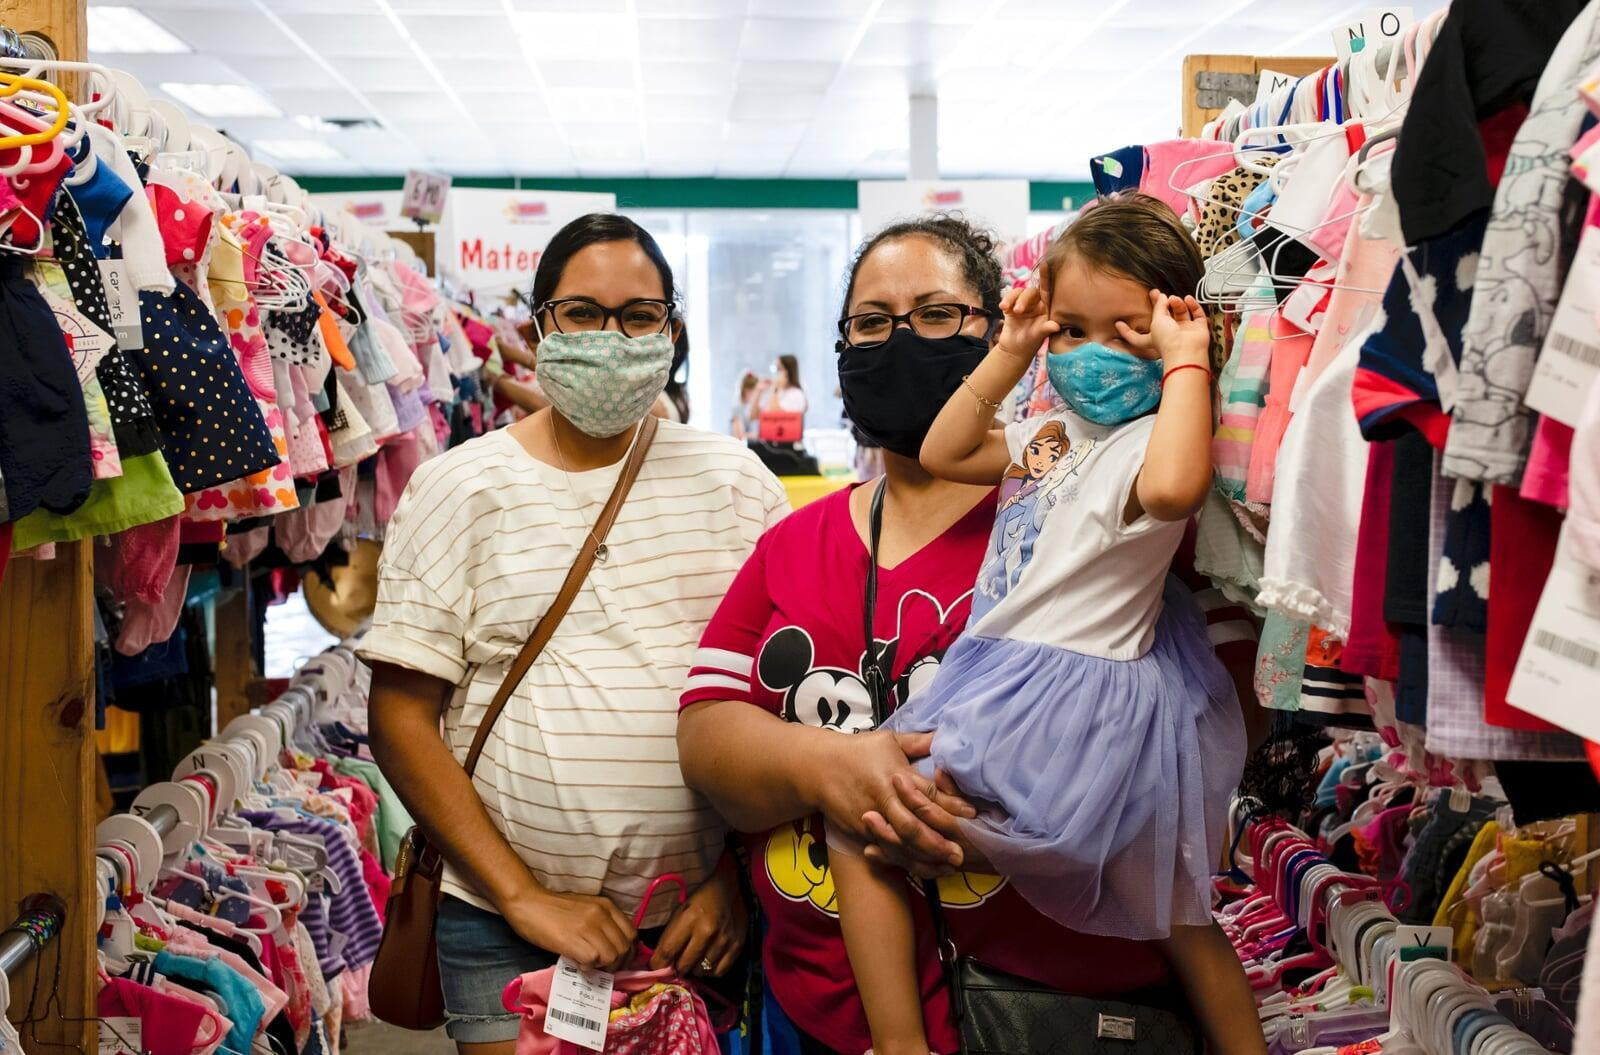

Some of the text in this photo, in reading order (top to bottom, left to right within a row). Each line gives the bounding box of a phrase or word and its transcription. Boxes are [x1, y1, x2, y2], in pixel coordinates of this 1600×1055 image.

[1380, 12, 1400, 37] O
[109, 271, 125, 320] carer's
[192, 754, 206, 770] N
